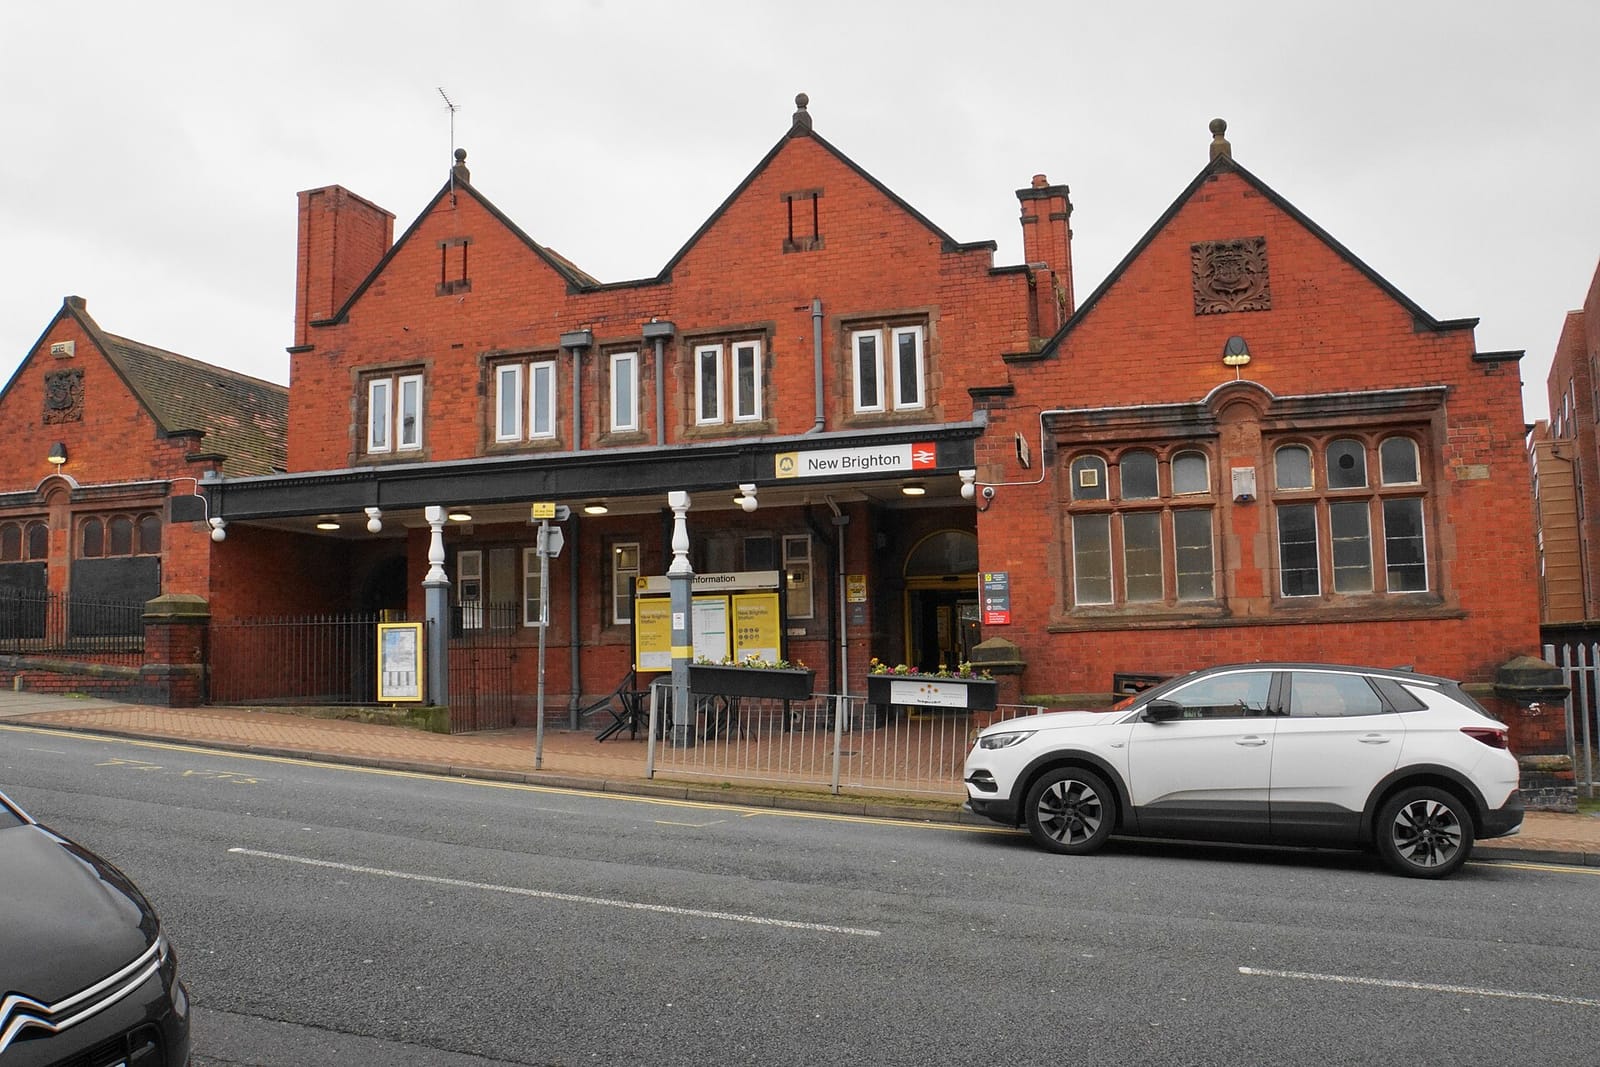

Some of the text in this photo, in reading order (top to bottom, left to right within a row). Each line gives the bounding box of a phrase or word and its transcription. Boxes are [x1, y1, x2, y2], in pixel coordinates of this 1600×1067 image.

[808, 454, 900, 469] New Brighton
[692, 575, 736, 584] nformation
